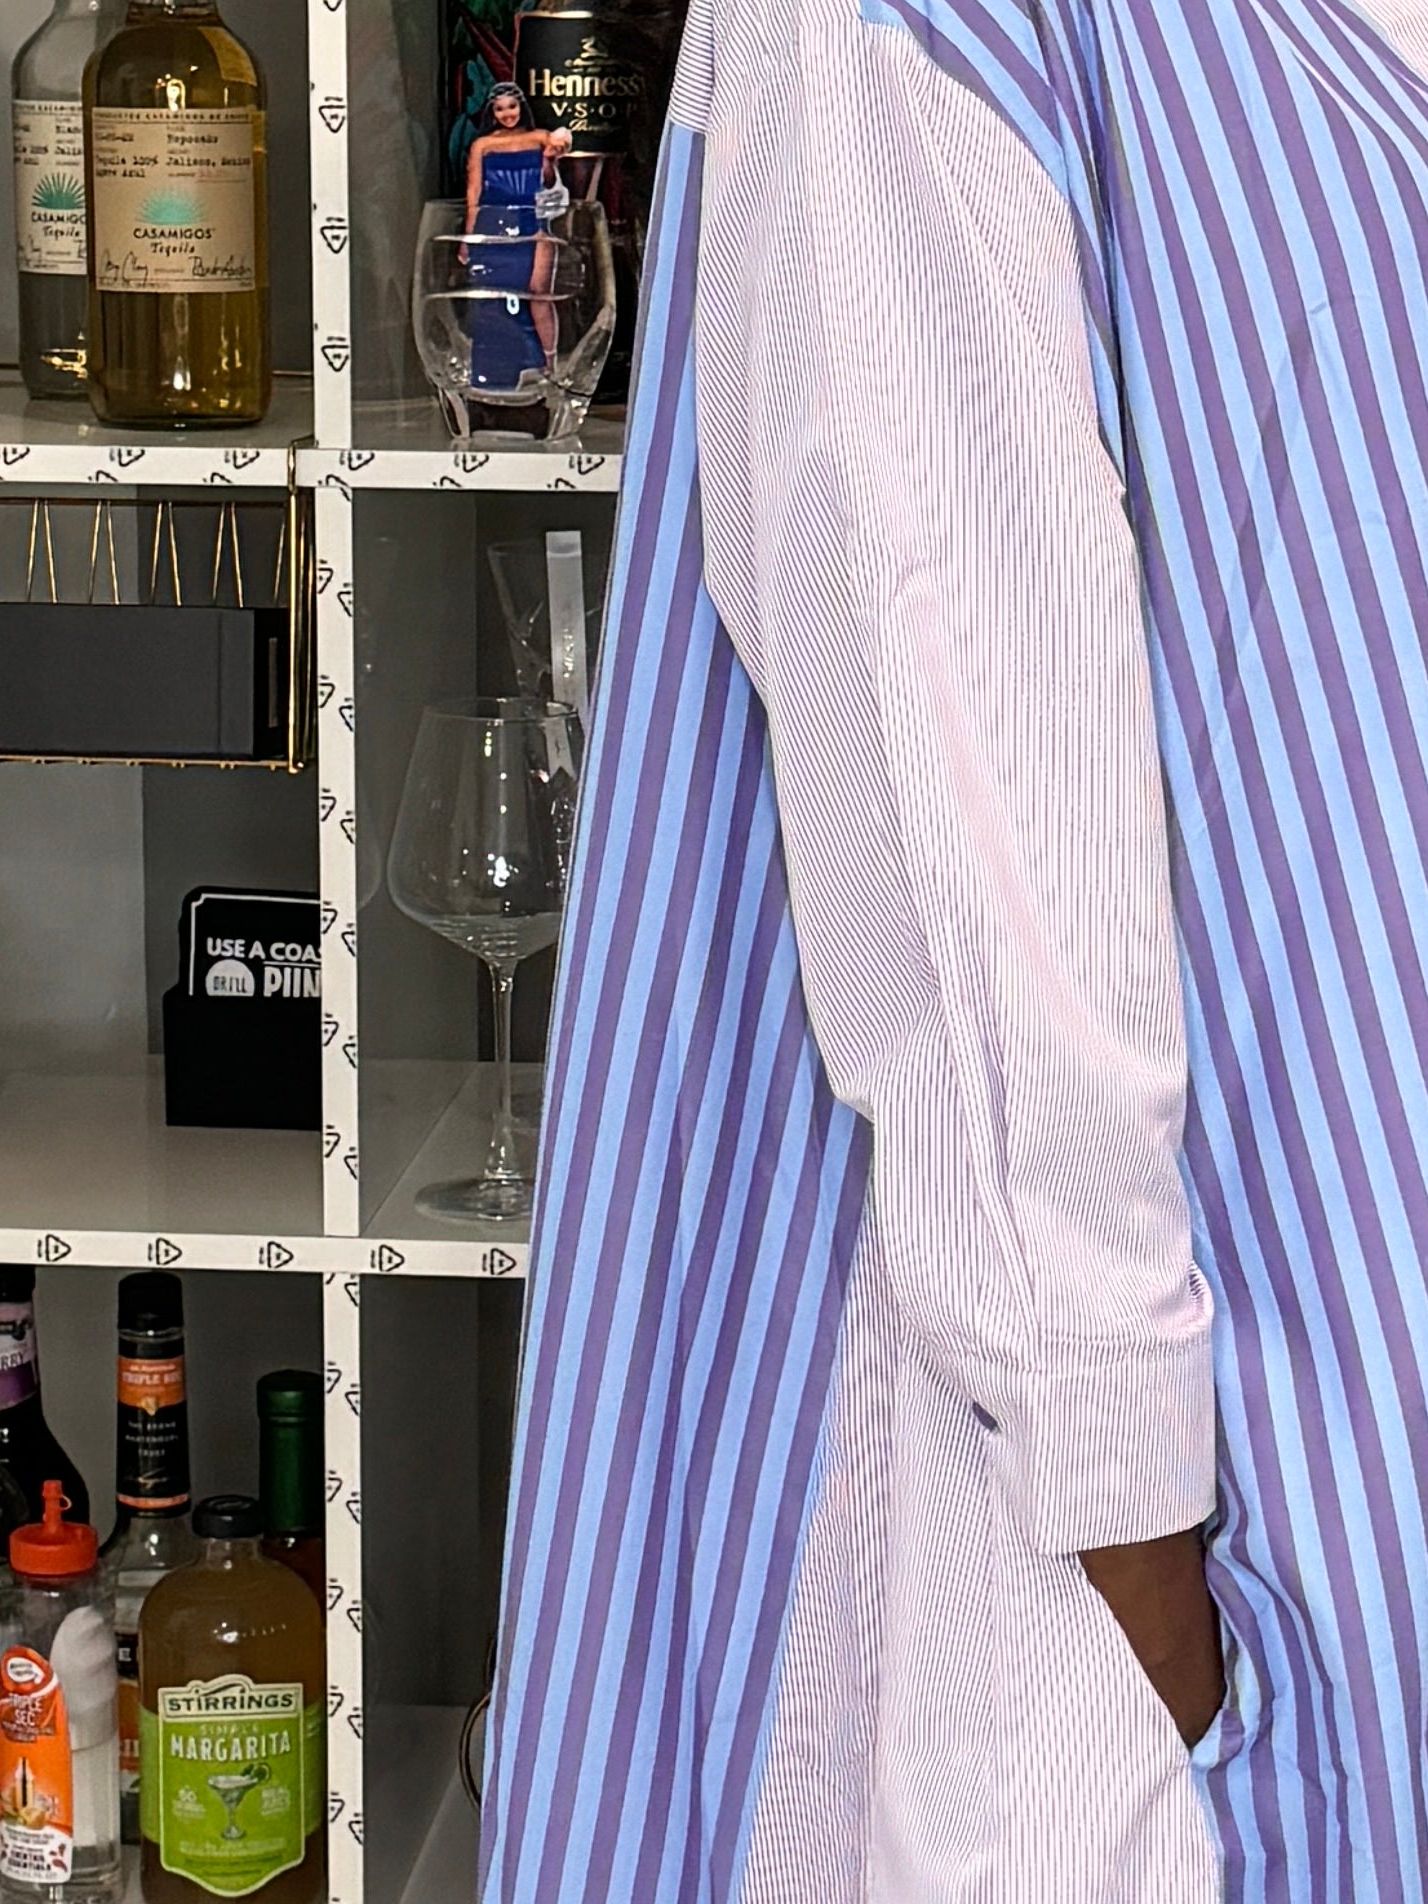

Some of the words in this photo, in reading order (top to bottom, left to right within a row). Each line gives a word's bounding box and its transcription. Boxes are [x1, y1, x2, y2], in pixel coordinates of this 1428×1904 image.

[529, 67, 646, 98] Henness
[133, 227, 213, 240] CASAMIGOS
[150, 242, 196, 257] Tequila
[206, 936, 245, 958] USE
[248, 940, 266, 959] A
[167, 1687, 294, 1712] STIRRINGS
[170, 1729, 292, 1762] MARGARITA
